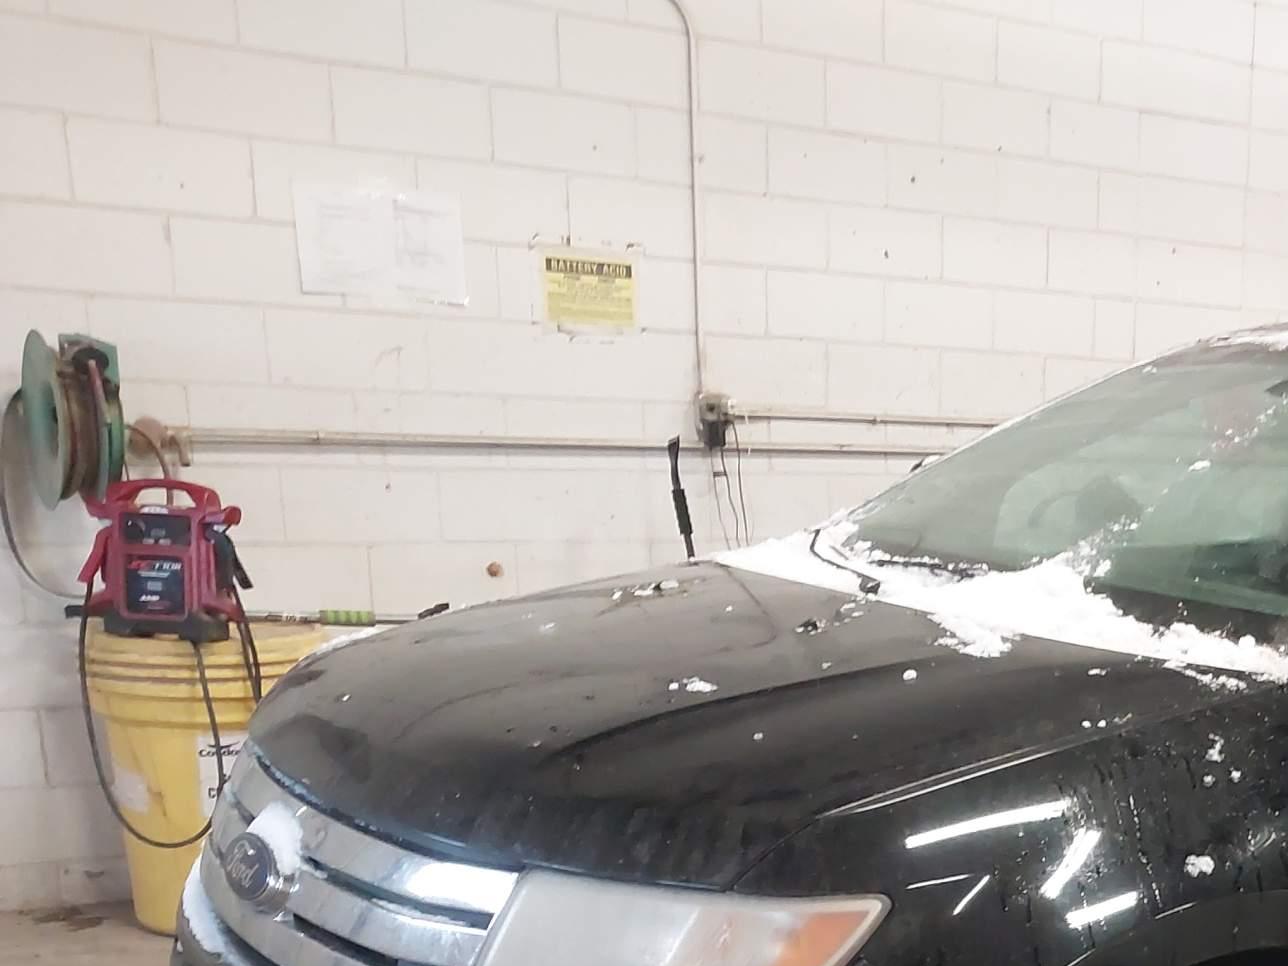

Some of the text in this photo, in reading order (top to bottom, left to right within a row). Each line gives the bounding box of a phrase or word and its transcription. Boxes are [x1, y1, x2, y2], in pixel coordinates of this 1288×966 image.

[549, 258, 627, 278] BATTERY ACID
[225, 840, 261, 888] Ford
